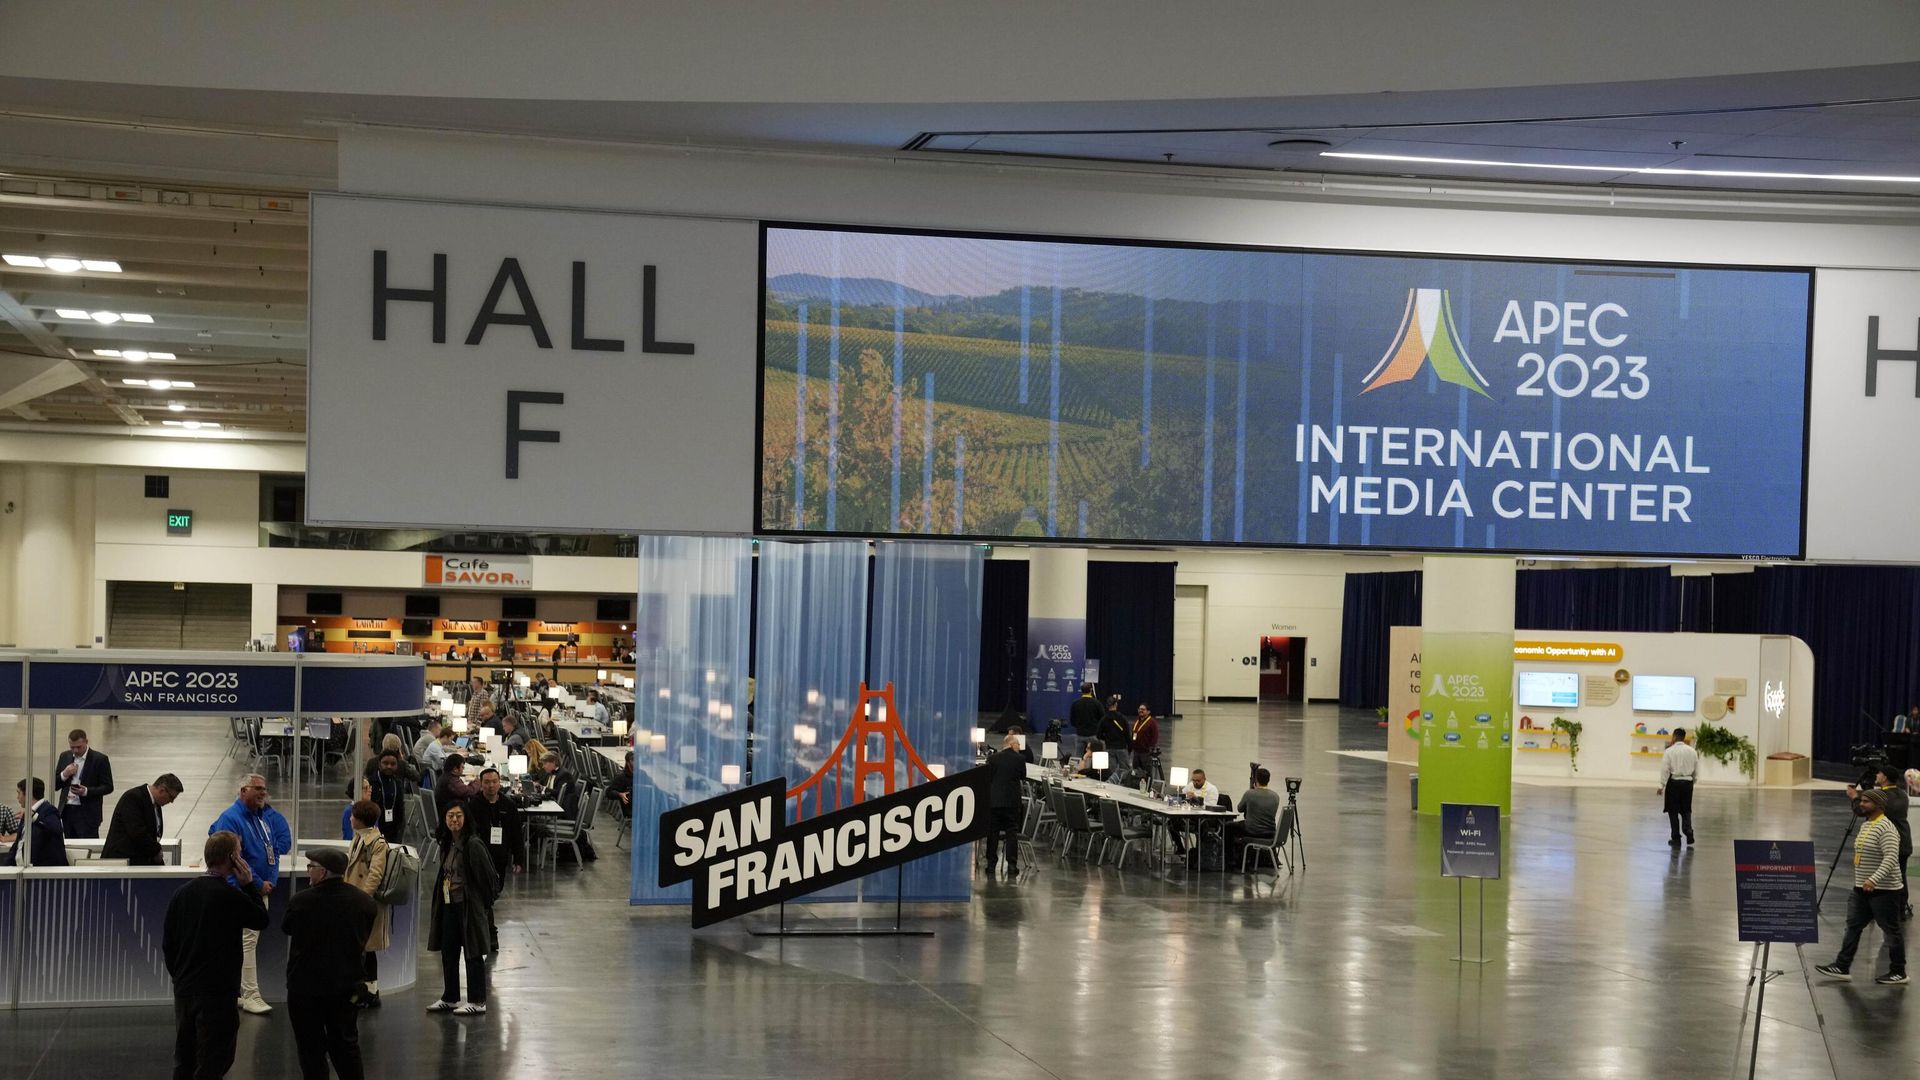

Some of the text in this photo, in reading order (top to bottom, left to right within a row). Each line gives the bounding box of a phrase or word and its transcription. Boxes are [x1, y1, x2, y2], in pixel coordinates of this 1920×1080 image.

[372, 249, 695, 355] HALL
[1492, 300, 1629, 347] APEC
[1865, 315, 1920, 398] H
[1516, 352, 1650, 400] 2023
[505, 390, 564, 480] F
[1295, 423, 1710, 474] INTERNATIONAL
[1310, 475, 1692, 523] MEDIA CENTER
[168, 515, 190, 527] EXIT
[445, 558, 489, 570] Café
[1271, 623, 1297, 631] Women
[1048, 644, 1069, 652] APEC
[1545, 646, 1590, 657] Opportunity
[1591, 648, 1607, 656] with
[1607, 648, 1616, 656] AI
[1051, 652, 1072, 660] 2023
[125, 671, 239, 689] APEC 2023
[1447, 674, 1479, 686] APEC
[125, 692, 238, 704] SAN FRANCISCO
[1452, 686, 1485, 697] 2023
[673, 795, 773, 867] SAN
[707, 786, 976, 910] FRANCISCO
[1759, 864, 1792, 872] IMPORTANT
